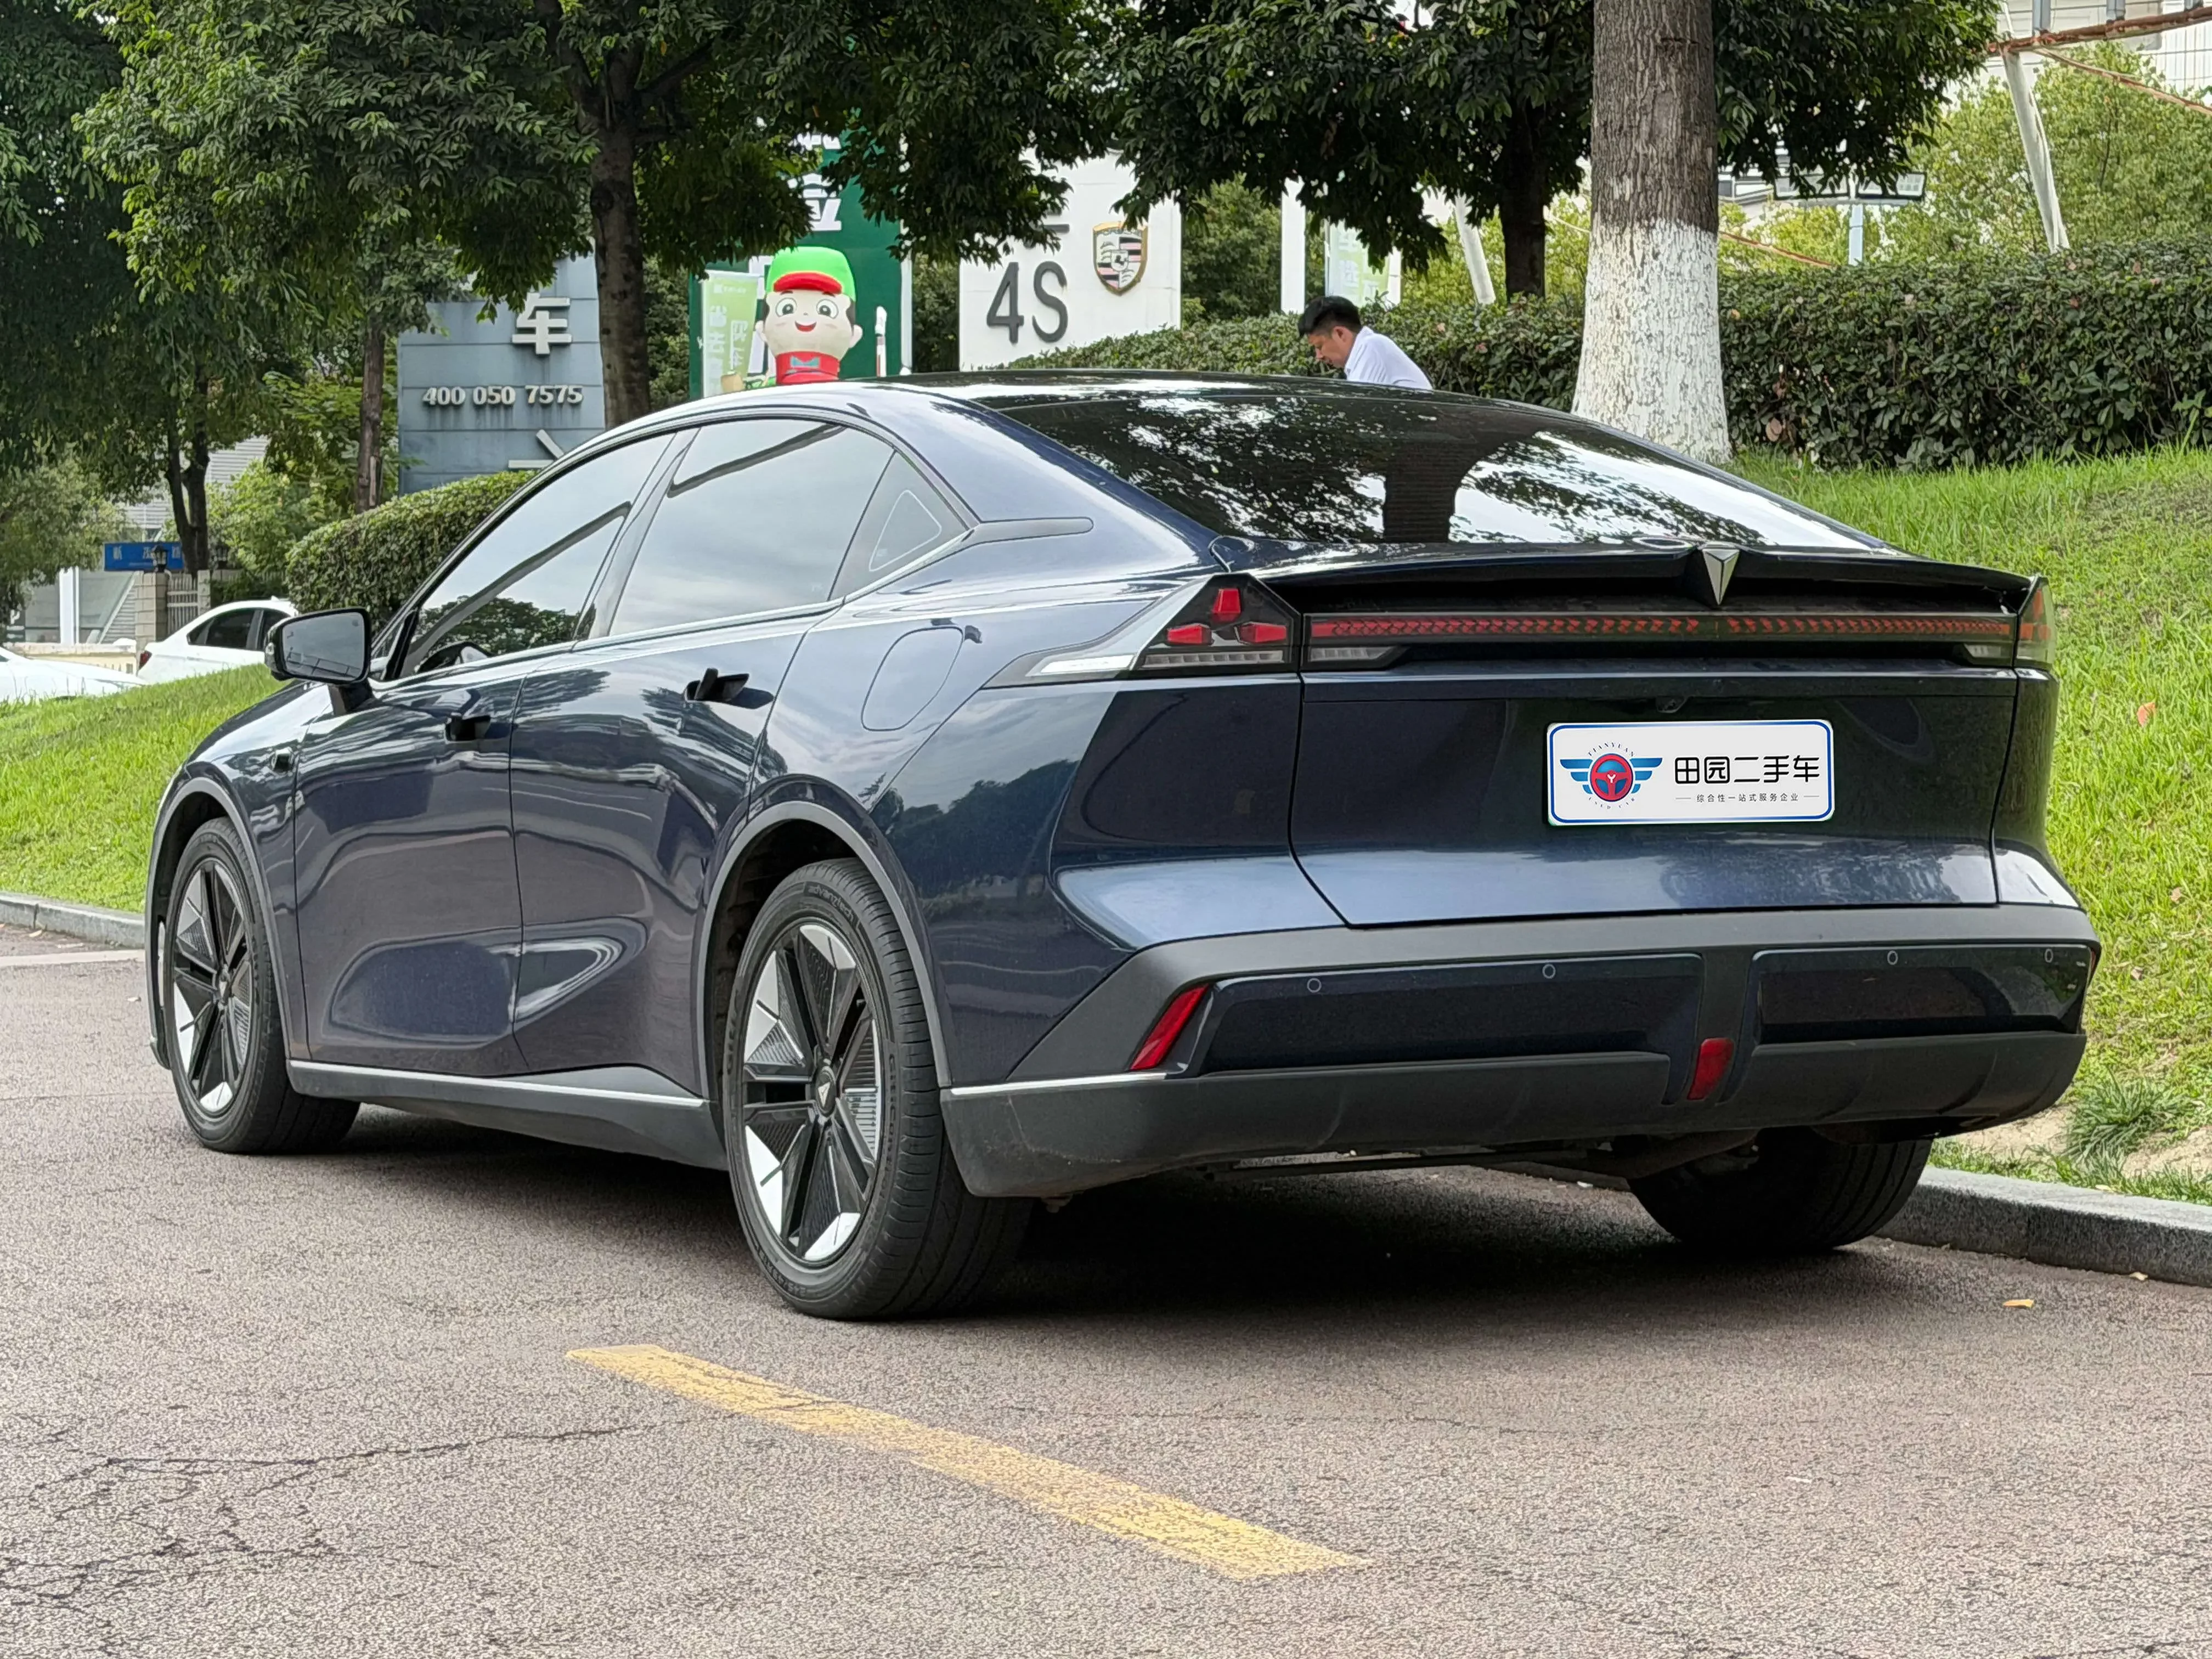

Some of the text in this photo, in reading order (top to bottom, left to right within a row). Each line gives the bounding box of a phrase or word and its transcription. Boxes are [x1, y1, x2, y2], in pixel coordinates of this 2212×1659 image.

[986, 261, 1068, 345] 4S
[512, 292, 572, 354] 车
[422, 385, 583, 405] 400 050 7575
[1675, 755, 1820, 784] 田园二手车
[1696, 793, 1798, 803] 综合性一站式服务企业
